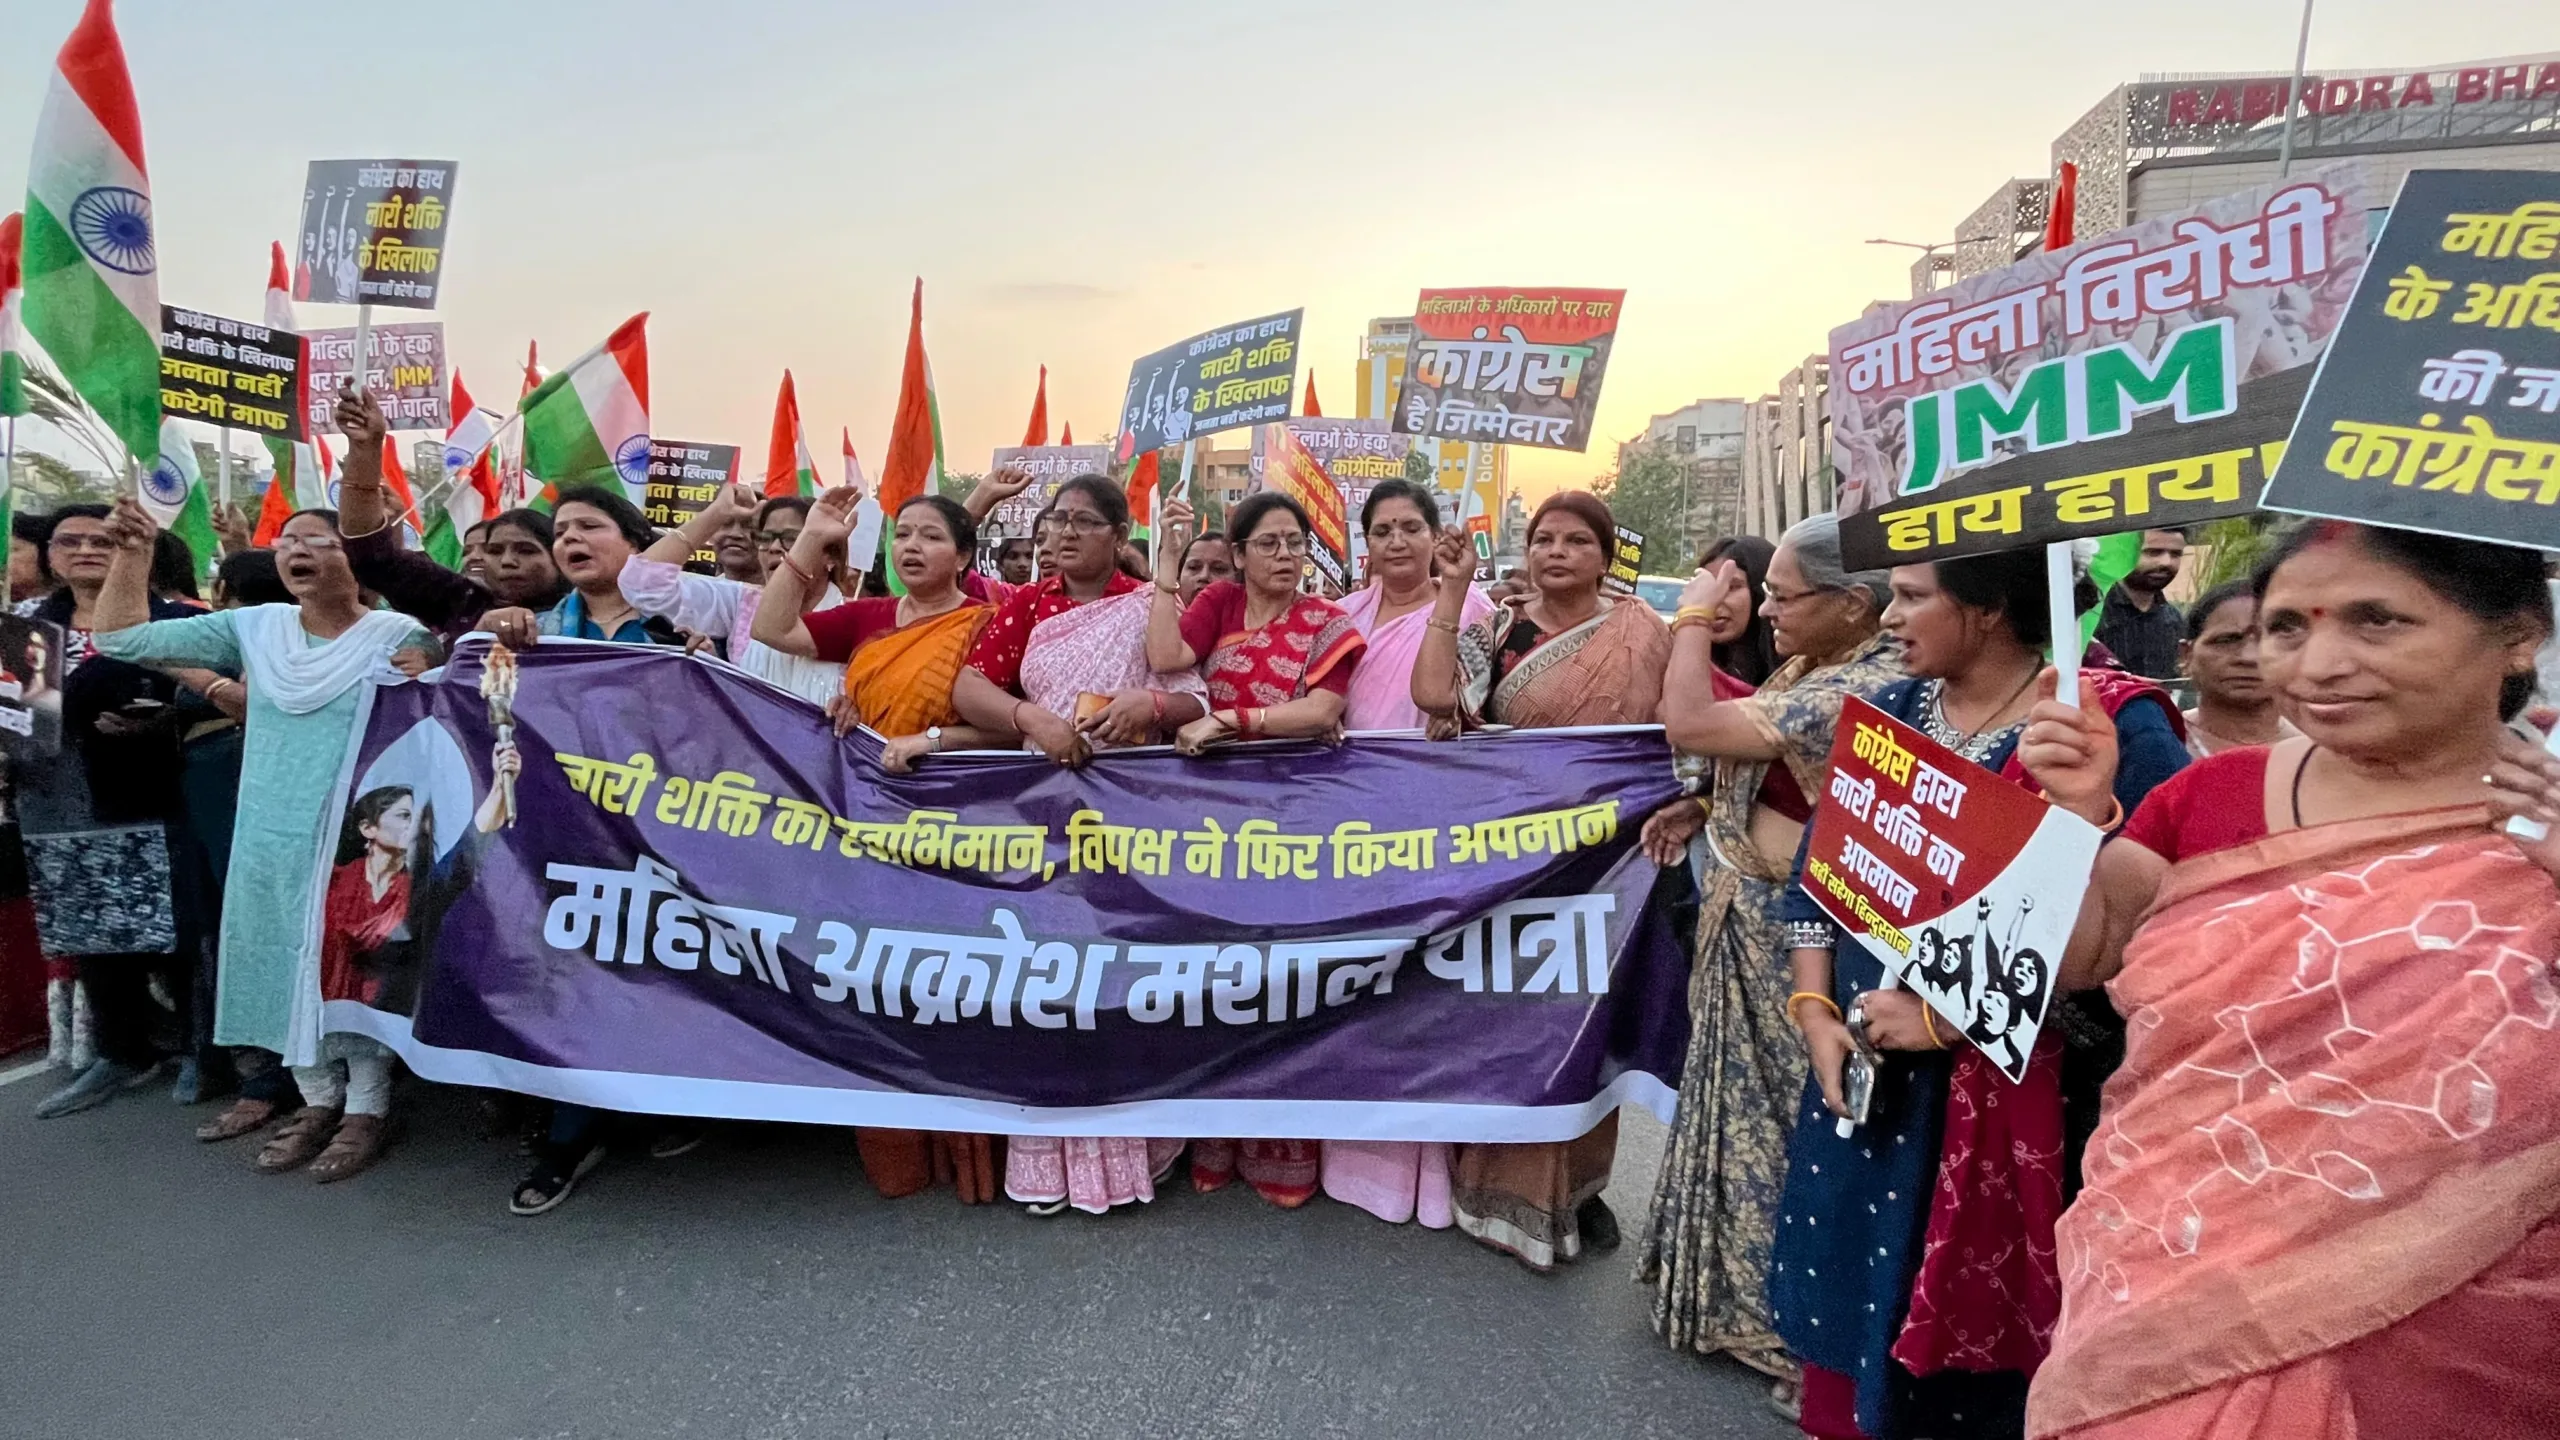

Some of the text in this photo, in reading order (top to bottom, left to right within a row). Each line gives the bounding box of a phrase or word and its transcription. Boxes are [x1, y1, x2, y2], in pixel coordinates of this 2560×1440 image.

[2168, 73, 2433, 126] RABINDRA
[358, 163, 446, 189] कांग्रेस का हाथ
[366, 195, 445, 230] नारी शक्ति
[359, 236, 439, 273] के खिलाफ
[1421, 294, 1614, 318] महिलाओं के अधिकारों पर वार
[1842, 186, 2337, 392] महिला विरोधी
[2383, 264, 2452, 321] के
[219, 318, 239, 337] का
[240, 322, 271, 343] हाथ
[381, 330, 401, 356] के
[402, 334, 433, 355] हक
[1189, 317, 1291, 356] कांग्रेस का हाथ
[161, 331, 296, 372] ारी शक्ति के खिलाफ
[1200, 338, 1295, 380] नारी शक्ति
[1416, 325, 1594, 399] कांग्रेस
[160, 357, 289, 399] जनता नहीं
[310, 372, 333, 391] पर
[393, 365, 433, 391] JMM
[1192, 374, 1292, 413] के खिलाफ
[2419, 349, 2507, 405] की
[159, 388, 289, 430] करेगी माफ
[310, 398, 331, 424] की
[401, 398, 439, 418] चाल
[1220, 410, 1239, 428] नहीं
[1239, 405, 1264, 423] करेगी
[1264, 404, 1287, 418] माफ
[1406, 395, 1574, 446] है जिम्मेदार
[1899, 317, 2236, 495] JMM
[669, 448, 685, 459] का
[687, 449, 710, 461] हाथ
[1343, 428, 1361, 449] के
[1363, 433, 1390, 450] हक
[2324, 411, 2560, 505] कांग्रेस
[670, 463, 681, 477] के
[682, 464, 727, 480] खिलाफ
[1056, 456, 1070, 474] के
[1071, 459, 1092, 474] हक
[1332, 454, 1406, 478] कांग्रेसियों
[1476, 442, 1493, 482] bloo
[676, 483, 720, 502] नहीं
[997, 504, 1013, 523] की
[1014, 504, 1024, 523] है
[1878, 486, 2031, 551] हाय
[1851, 721, 1968, 820] कांग्रेस द्वारा
[654, 771, 772, 836] शक्ति
[771, 796, 836, 851] का
[831, 810, 1055, 882] स्वाभिमान,
[1065, 810, 1178, 876] विपक्ष
[1184, 816, 1228, 879] ने
[1234, 819, 1325, 880] फिर
[1329, 821, 1438, 879] किया
[1449, 799, 1620, 864] अपमान
[1831, 766, 1966, 887] नारी शक्ति का
[1839, 834, 1920, 918] अपमान
[1809, 856, 1913, 961] नहीं सहेगा हिन्दुस्तान
[543, 854, 1615, 1030] महिला आक्रोश मशाल यात्रा
